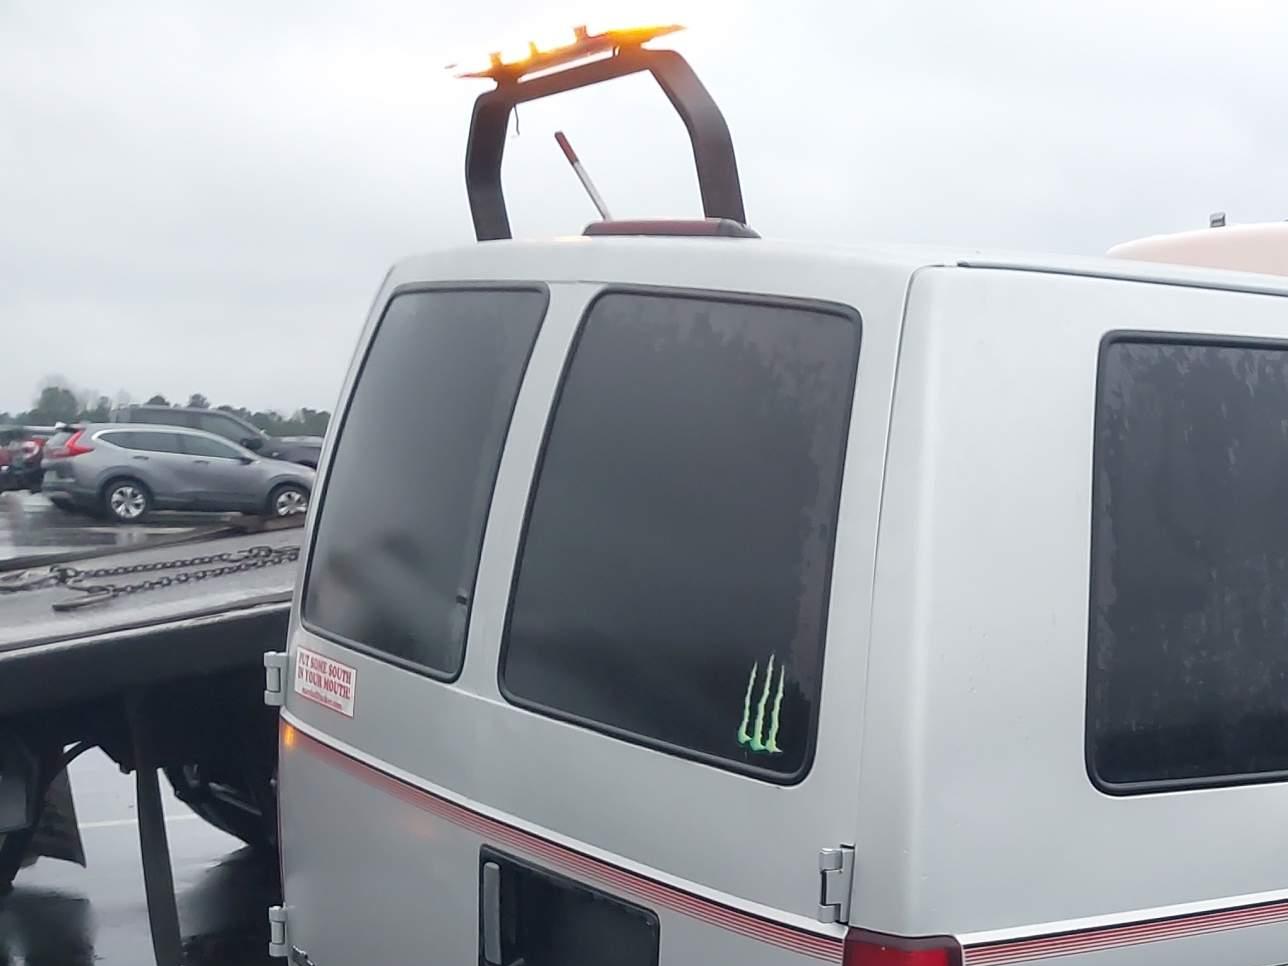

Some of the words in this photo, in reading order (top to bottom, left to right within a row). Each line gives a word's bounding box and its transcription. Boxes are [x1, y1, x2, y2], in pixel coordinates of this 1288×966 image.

[305, 669, 322, 689] YOUR
[311, 656, 327, 673] SOME
[328, 664, 352, 685] SOUTH
